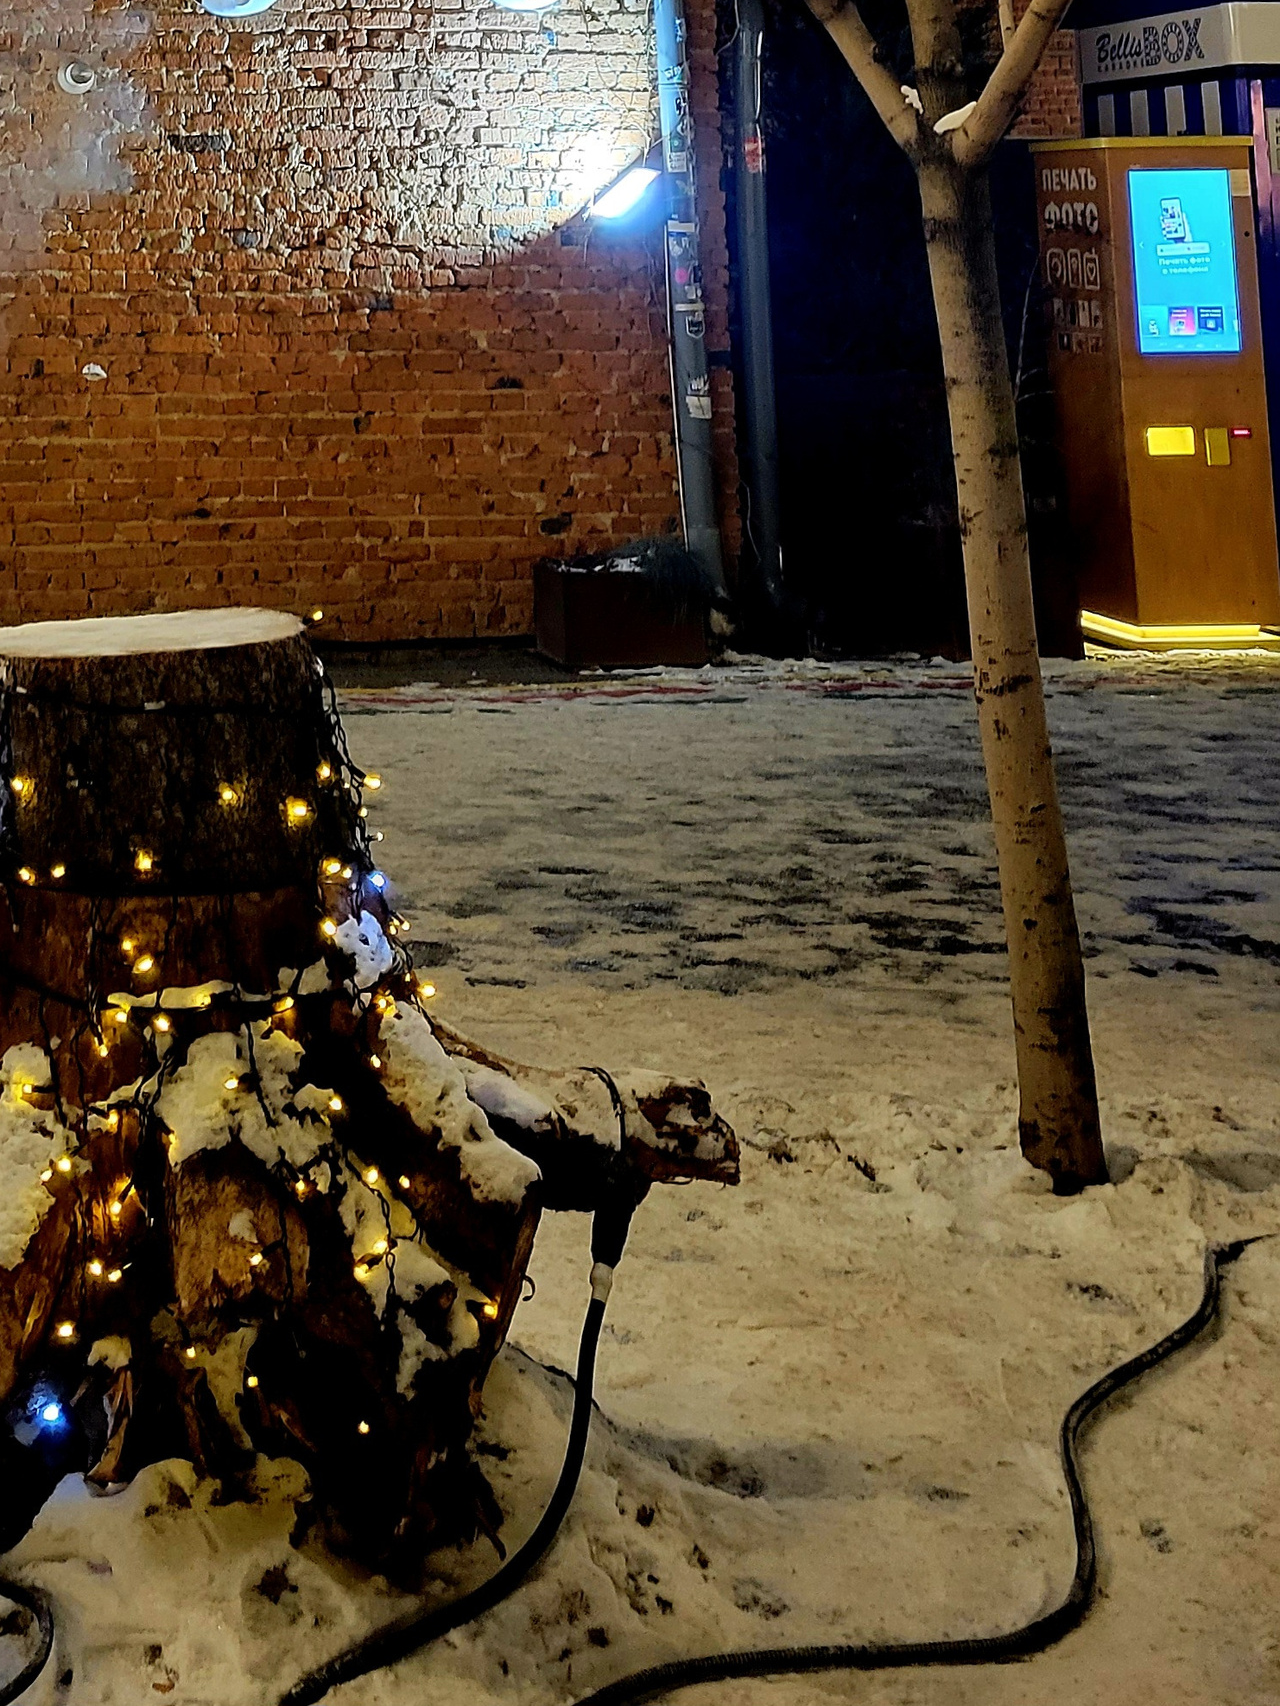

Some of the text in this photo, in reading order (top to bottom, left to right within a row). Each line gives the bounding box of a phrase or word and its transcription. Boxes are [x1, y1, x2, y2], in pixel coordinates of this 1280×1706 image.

[1096, 18, 1205, 66] Bellis BOX
[1042, 167, 1097, 192] ПЕЧАТЬ
[1044, 201, 1099, 234] ФОТО
